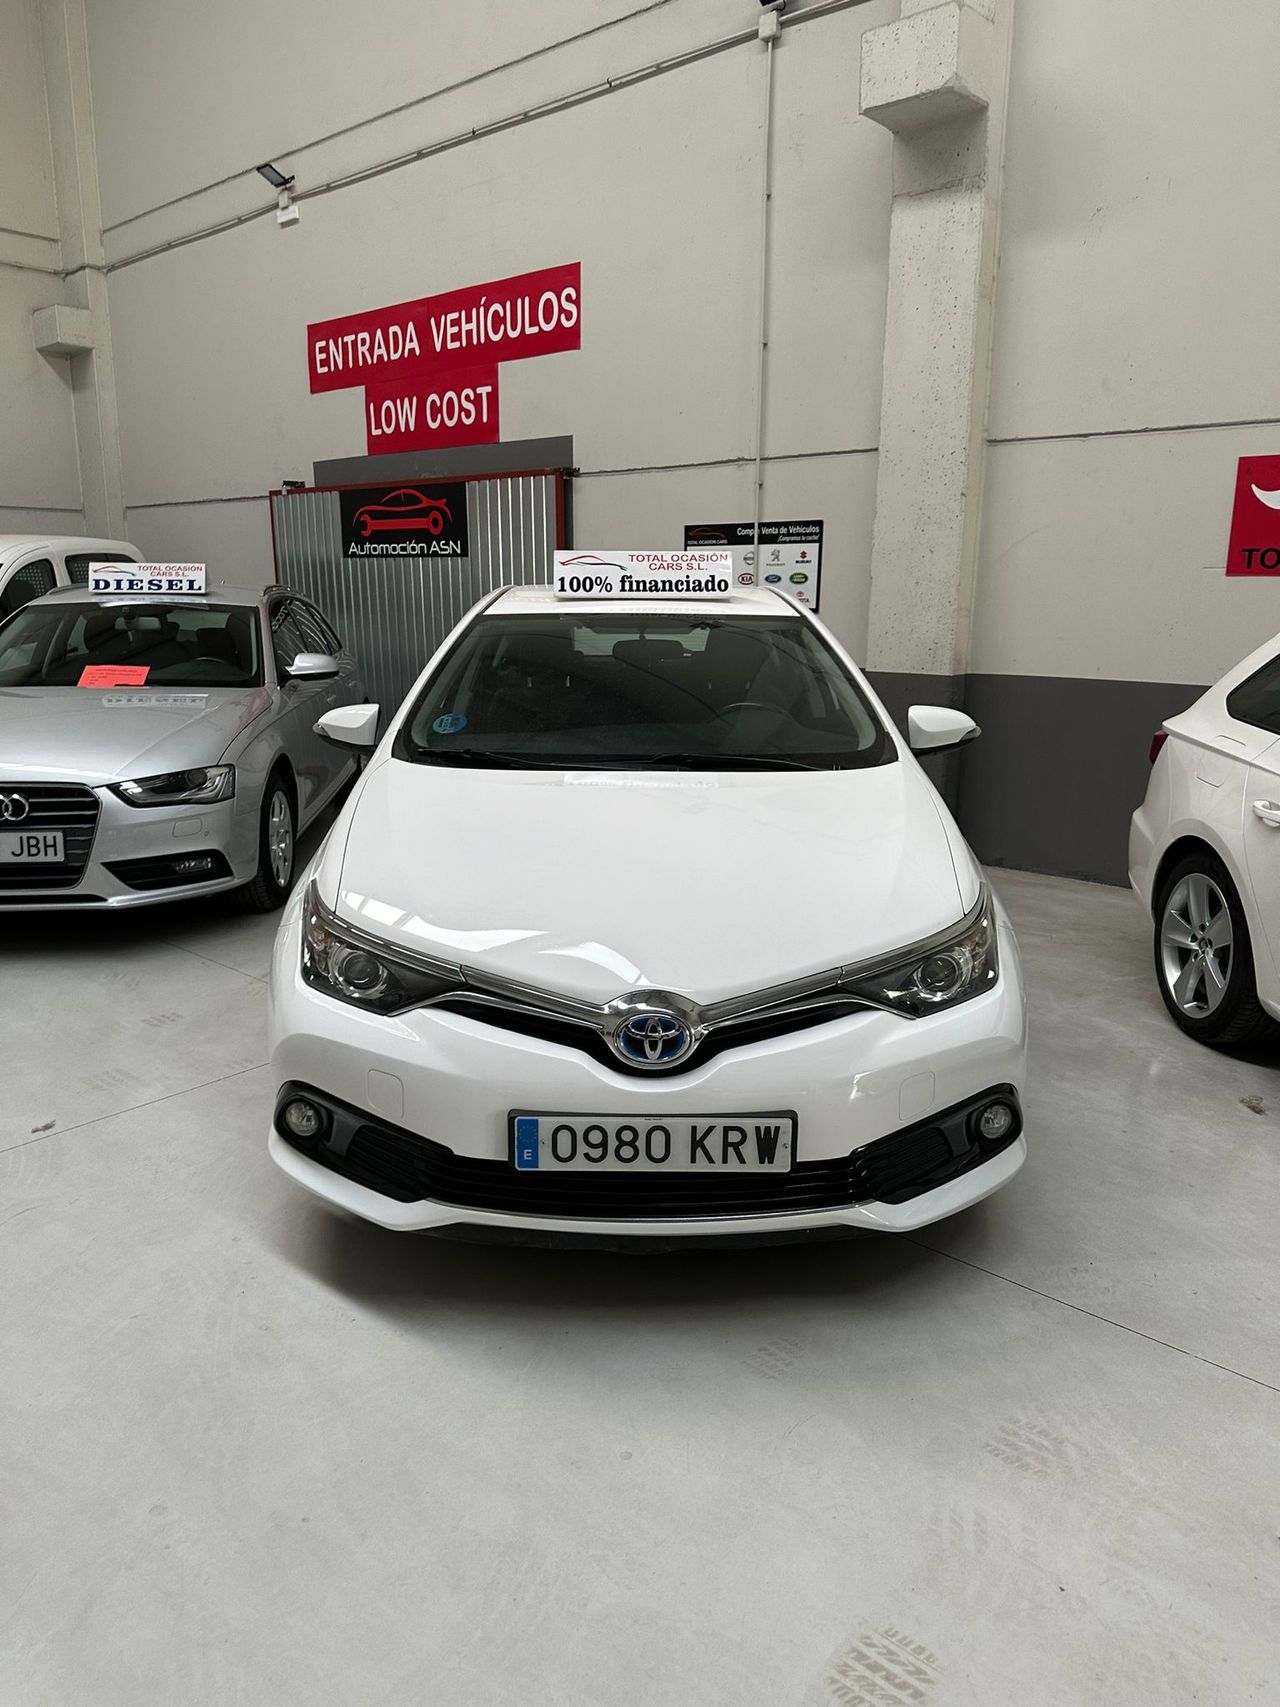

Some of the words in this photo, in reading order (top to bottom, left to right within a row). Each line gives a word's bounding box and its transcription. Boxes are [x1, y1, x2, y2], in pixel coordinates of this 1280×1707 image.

[314, 320, 421, 375] ENTRADA
[430, 286, 579, 354] VEHÍCULOS
[369, 396, 418, 437] LOW
[425, 385, 493, 430] COST
[737, 527, 760, 536] Compa
[761, 526, 778, 535] Venta
[779, 525, 788, 534] de
[789, 524, 820, 534] Vehículos
[348, 539, 427, 555] Automoción
[429, 540, 461, 555] ASN
[628, 553, 668, 563] TOTAL
[671, 552, 728, 563] OCASIÓN
[1241, 547, 1280, 570] TO
[648, 562, 683, 571] CARS
[686, 562, 708, 571] S.L.
[92, 578, 202, 591] DIESEL
[557, 575, 613, 593] 100%
[619, 574, 729, 593] financiado
[11, 835, 58, 857] JBH
[551, 1124, 672, 1164] 0980
[689, 1125, 781, 1165] KRW
[523, 1149, 533, 1160] E
